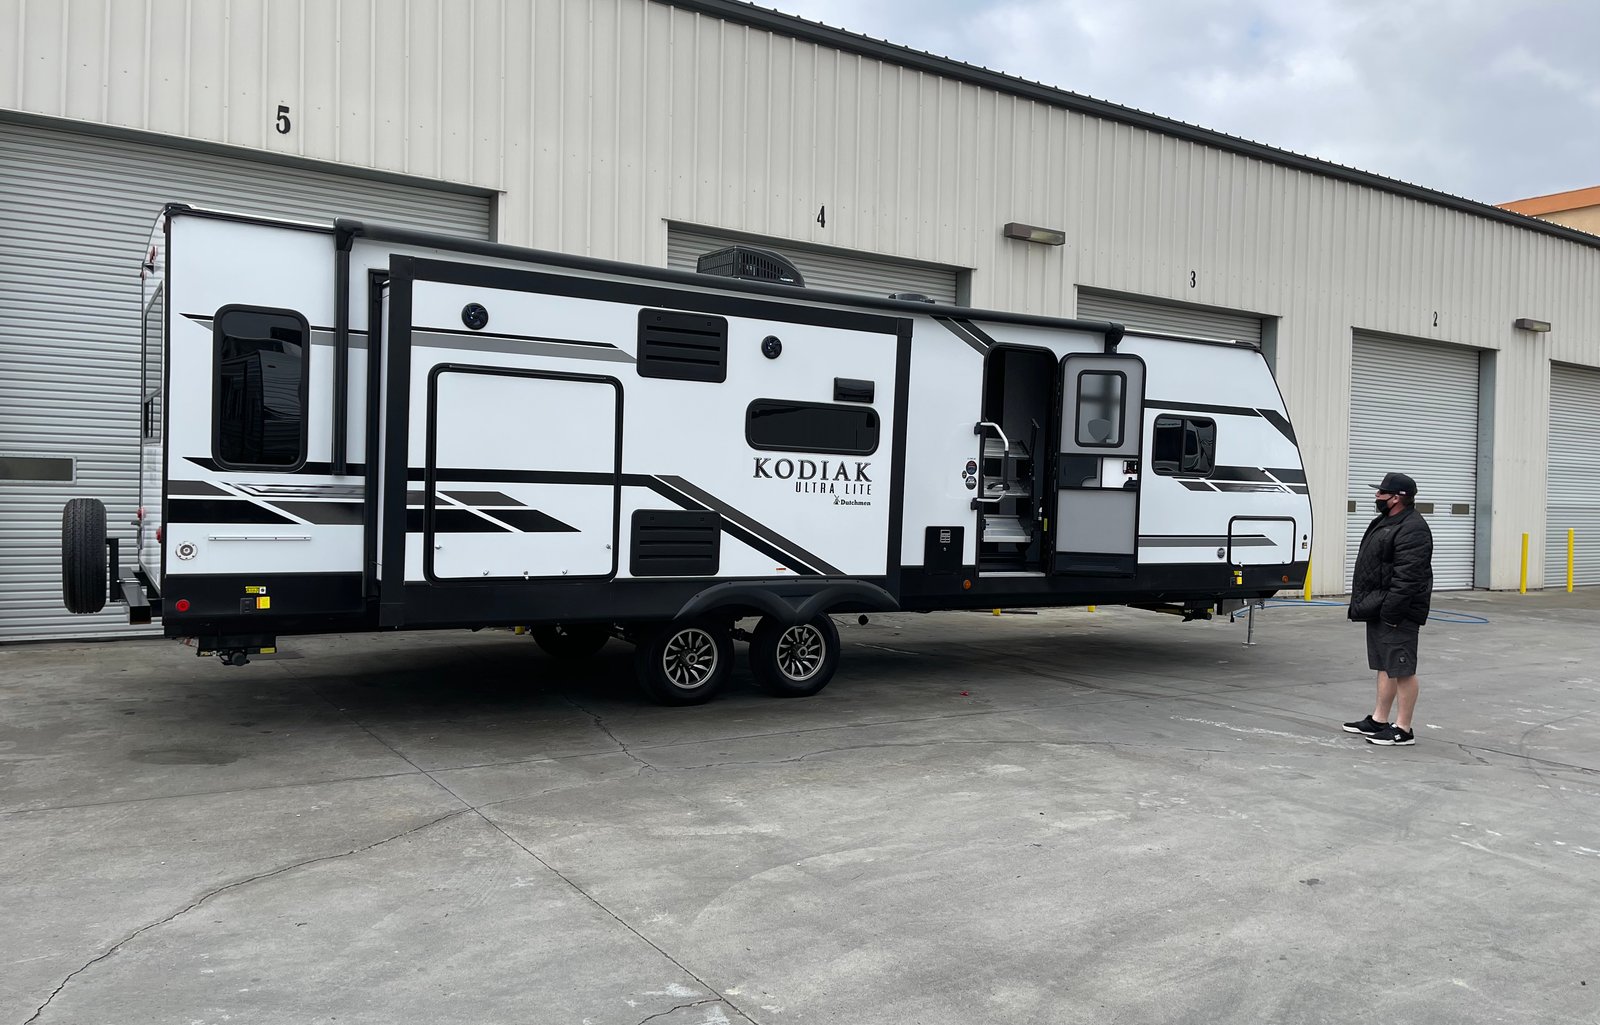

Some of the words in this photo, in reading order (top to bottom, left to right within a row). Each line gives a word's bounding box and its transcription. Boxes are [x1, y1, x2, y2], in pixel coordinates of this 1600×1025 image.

[276, 104, 291, 134] 5
[816, 205, 826, 228] 4
[1190, 270, 1196, 288] 3
[1432, 311, 1438, 327] 2
[753, 457, 872, 482] KODIAK
[795, 481, 835, 494] ULTRA
[845, 483, 872, 495] LITE
